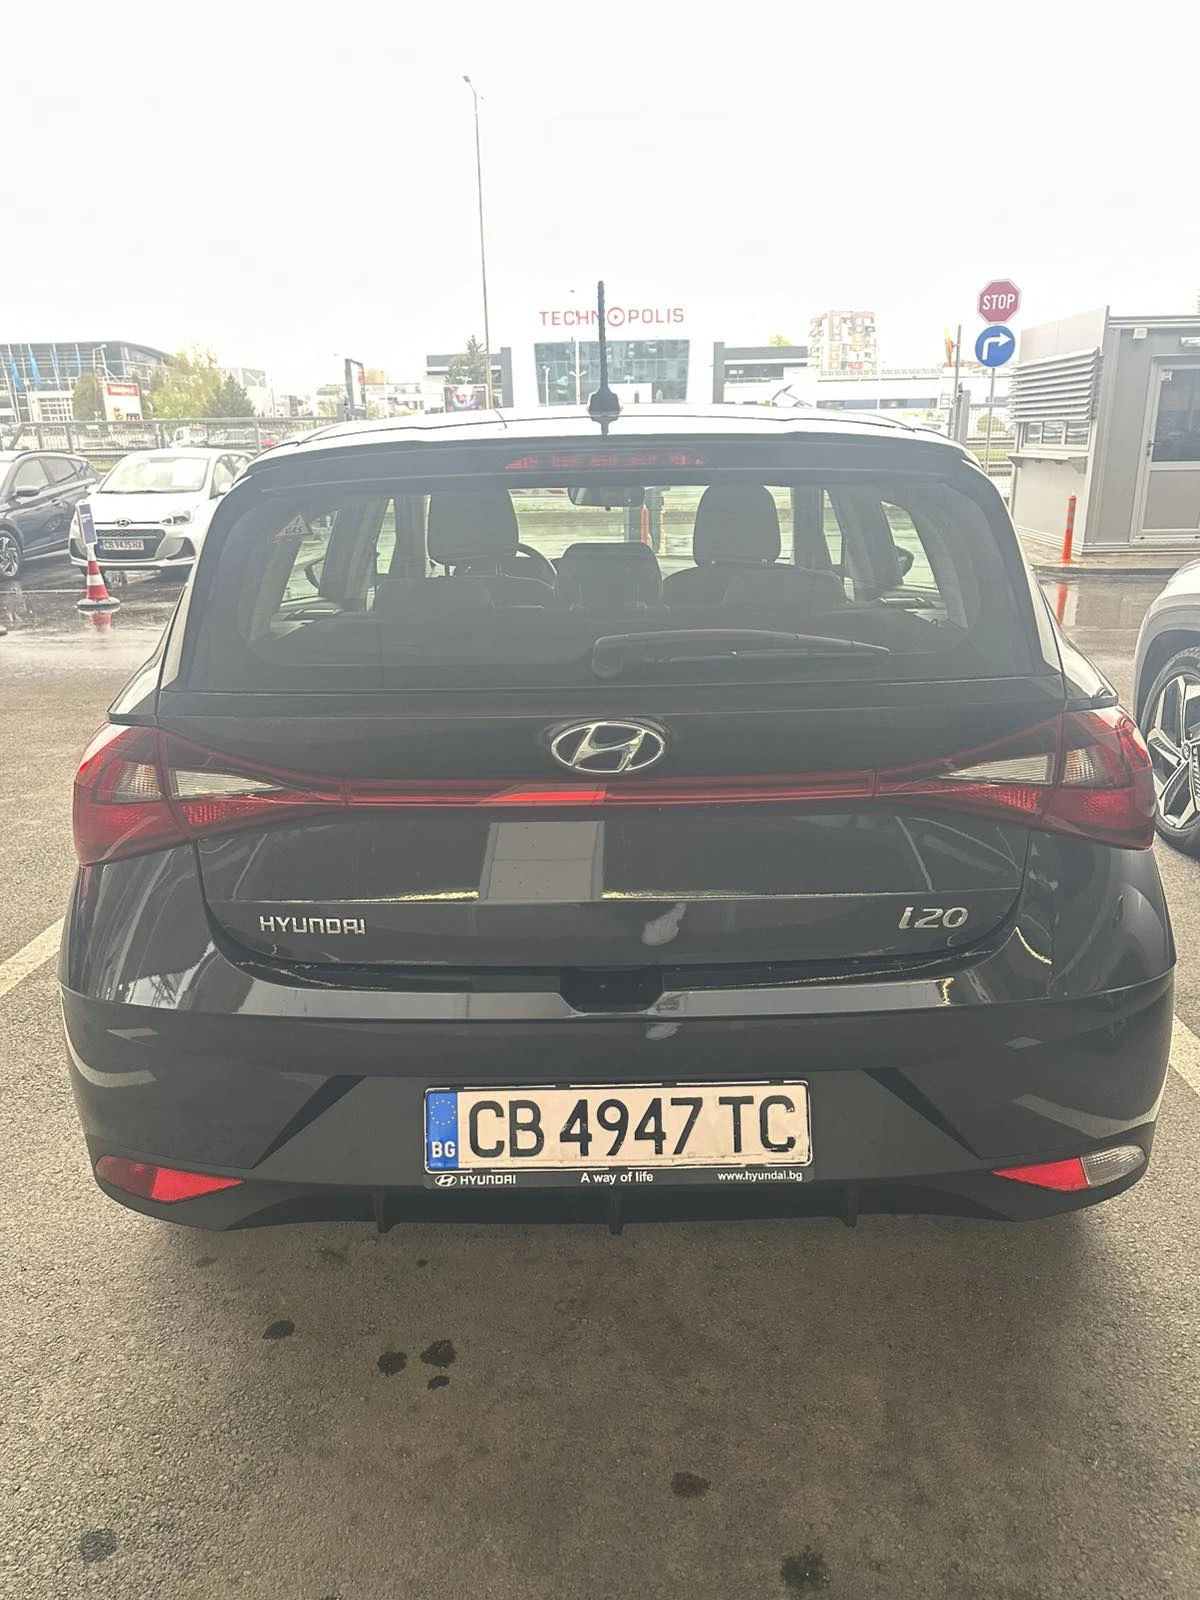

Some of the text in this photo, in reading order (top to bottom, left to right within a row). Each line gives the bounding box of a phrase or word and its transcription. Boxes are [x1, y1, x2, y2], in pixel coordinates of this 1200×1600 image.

[983, 293, 1016, 310] STOP
[259, 915, 366, 935] HYUNDAI
[898, 906, 969, 929] i20
[468, 1094, 796, 1159] CB 4947 TC
[431, 1140, 456, 1158] BG
[460, 1175, 517, 1186] HYUNDAI
[580, 1173, 654, 1185] A way of life
[717, 1170, 804, 1183] www.hyundai.bg
